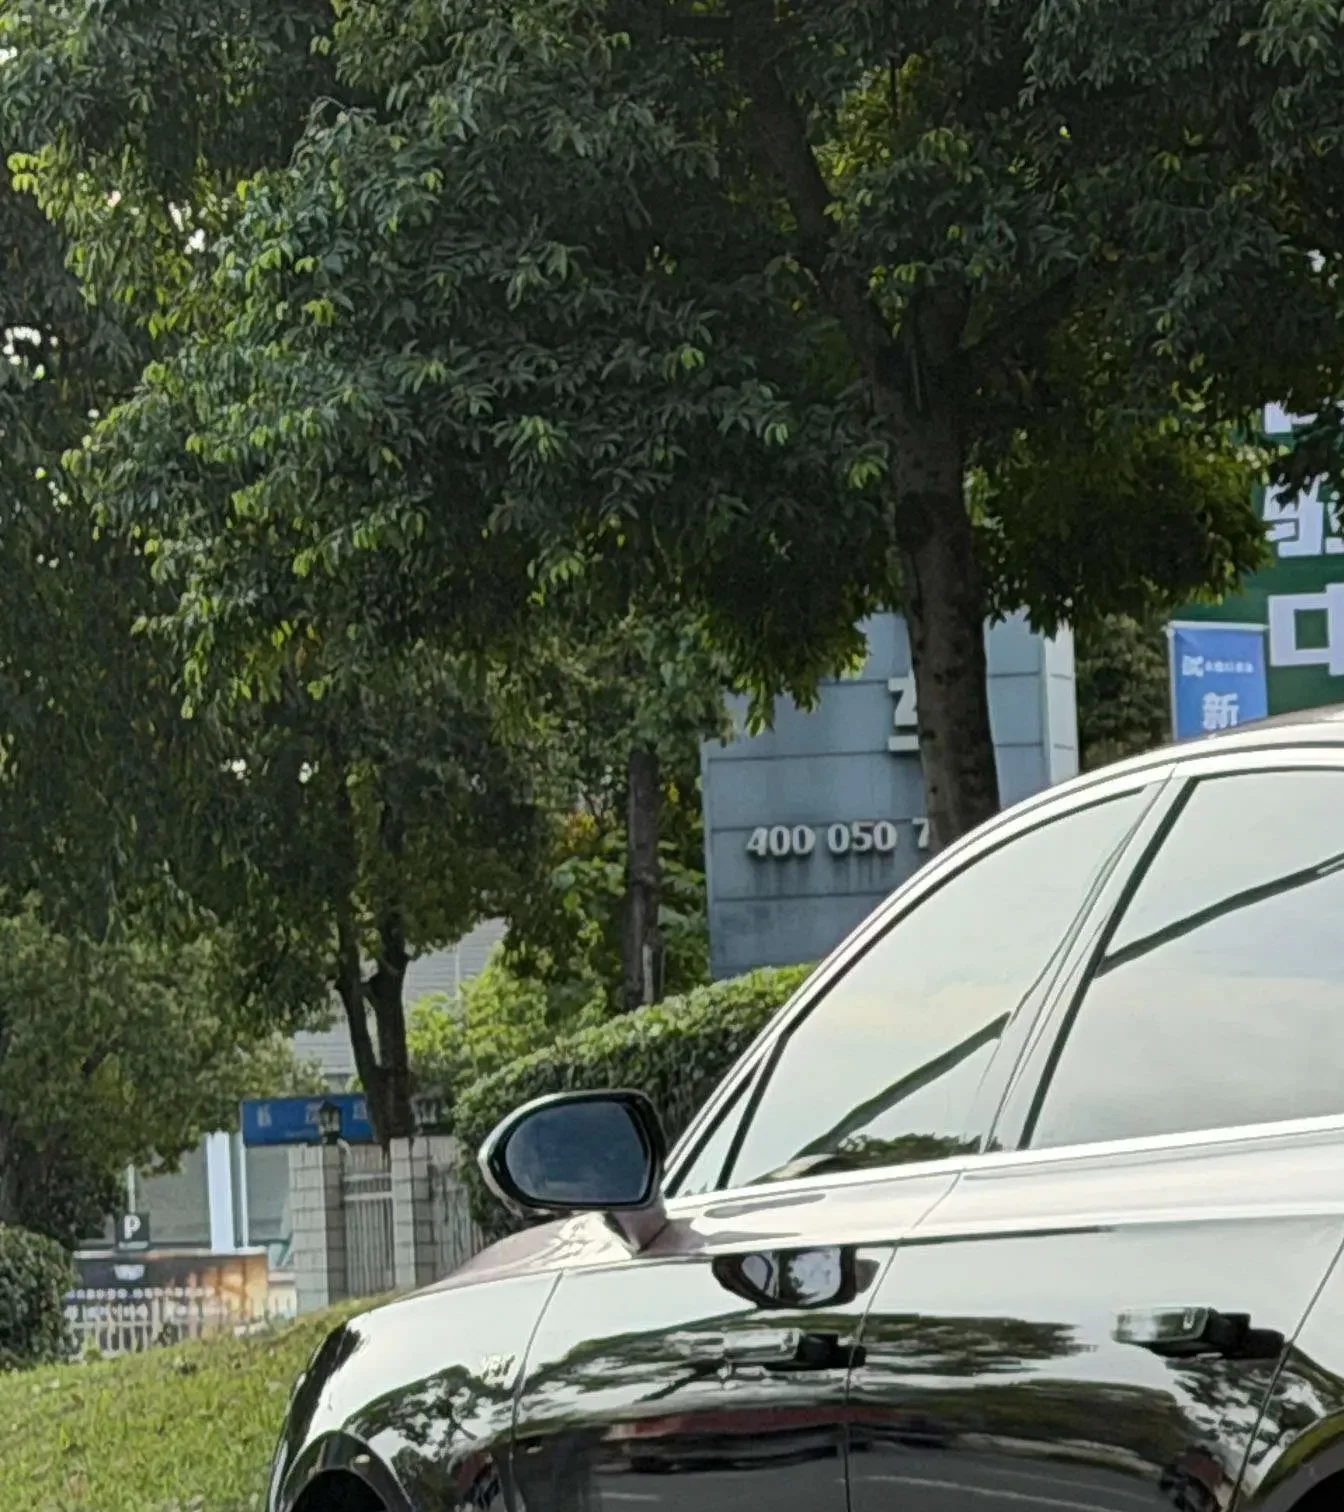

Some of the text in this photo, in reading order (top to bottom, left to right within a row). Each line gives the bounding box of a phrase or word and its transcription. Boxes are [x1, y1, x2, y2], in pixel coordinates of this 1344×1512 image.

[1202, 692, 1240, 730] 新
[746, 825, 814, 857] 400
[828, 820, 897, 855] 050
[124, 1215, 141, 1239] P
